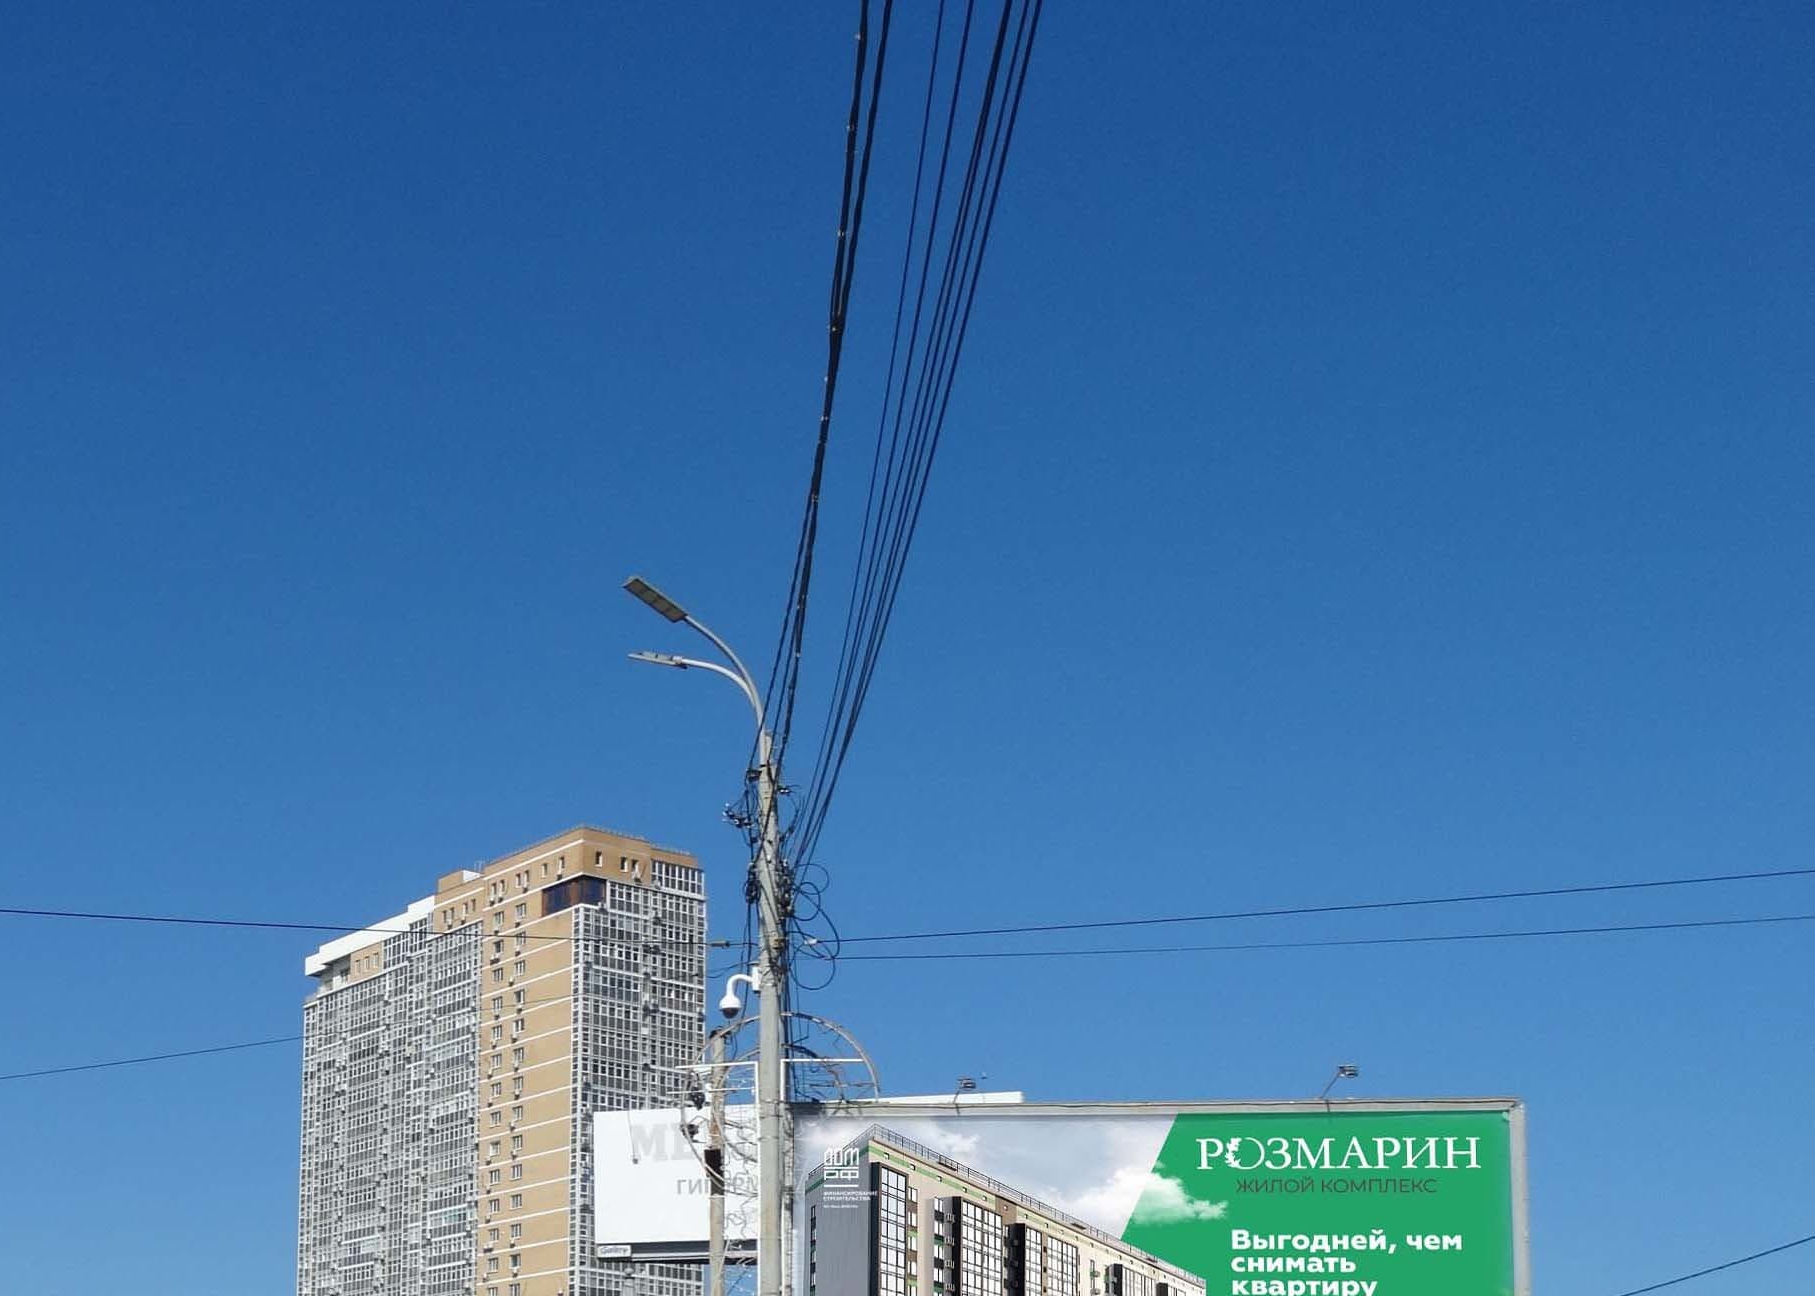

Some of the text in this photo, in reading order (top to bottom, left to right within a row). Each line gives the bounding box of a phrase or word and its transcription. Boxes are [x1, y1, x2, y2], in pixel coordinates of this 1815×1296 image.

[1196, 1136, 1481, 1170] РОЗМАРИН
[1236, 1176, 1438, 1194] ЖИЛОЙ КОМПЛЕКС
[1231, 1229, 1463, 1254] Выгодней, чем
[1230, 1256, 1356, 1274] снимать
